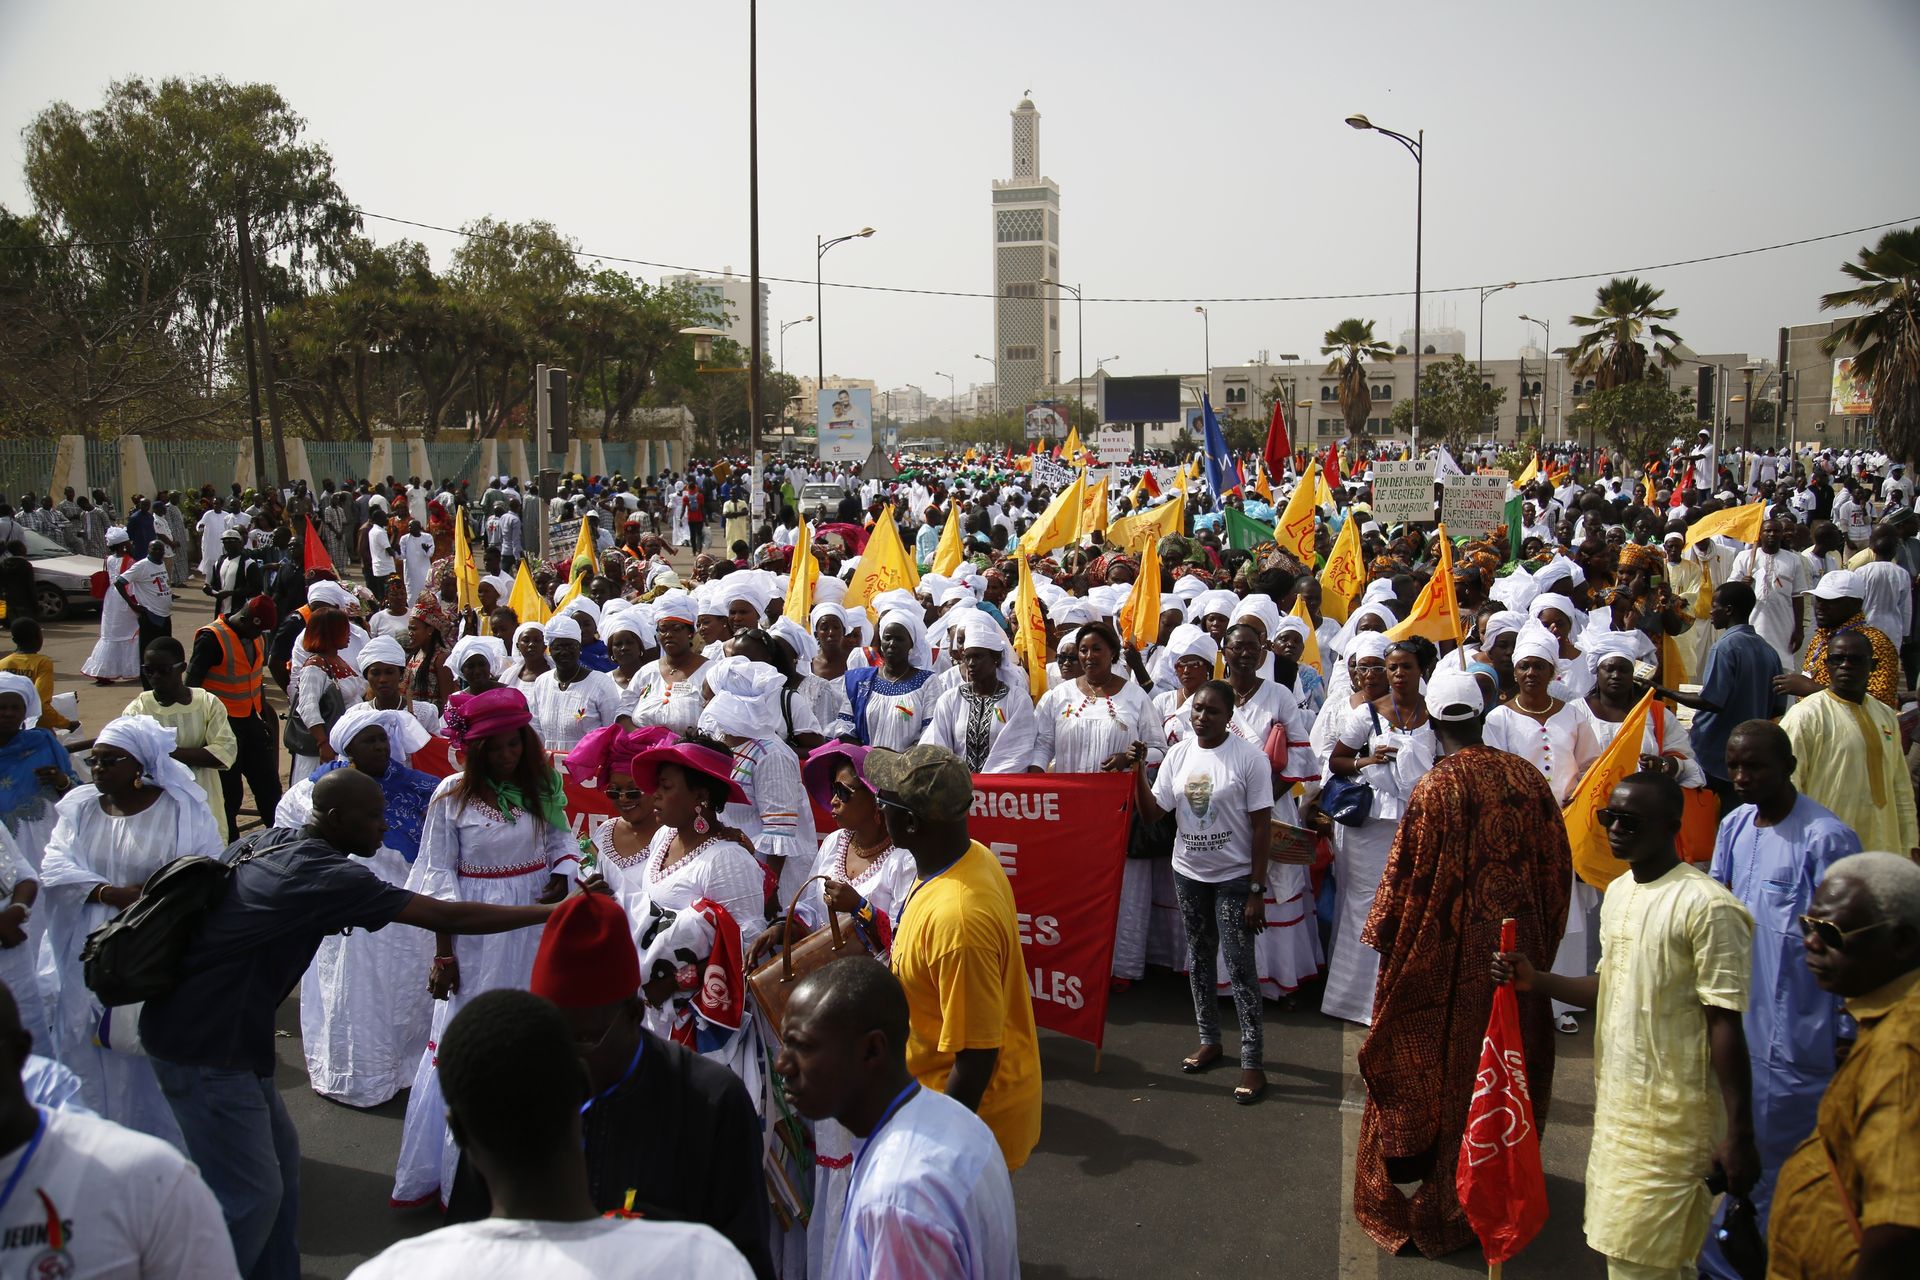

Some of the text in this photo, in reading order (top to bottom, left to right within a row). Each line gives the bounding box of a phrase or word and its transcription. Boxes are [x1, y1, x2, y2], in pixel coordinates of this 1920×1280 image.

[1399, 463, 1409, 472] CSI
[1374, 475, 1434, 488] FIN DES HORAIRES
[1472, 477, 1482, 487] CSI
[1375, 488, 1426, 500] DE NEGRIERS
[1444, 488, 1504, 500] POUR LA TRANSITION
[1375, 504, 1381, 513] A
[1444, 499, 1453, 508] DE
[1443, 509, 1501, 520] INFORMELLE VERS
[1211, 831, 1233, 840] DIOP
[1, 1218, 74, 1251] JEUNS
